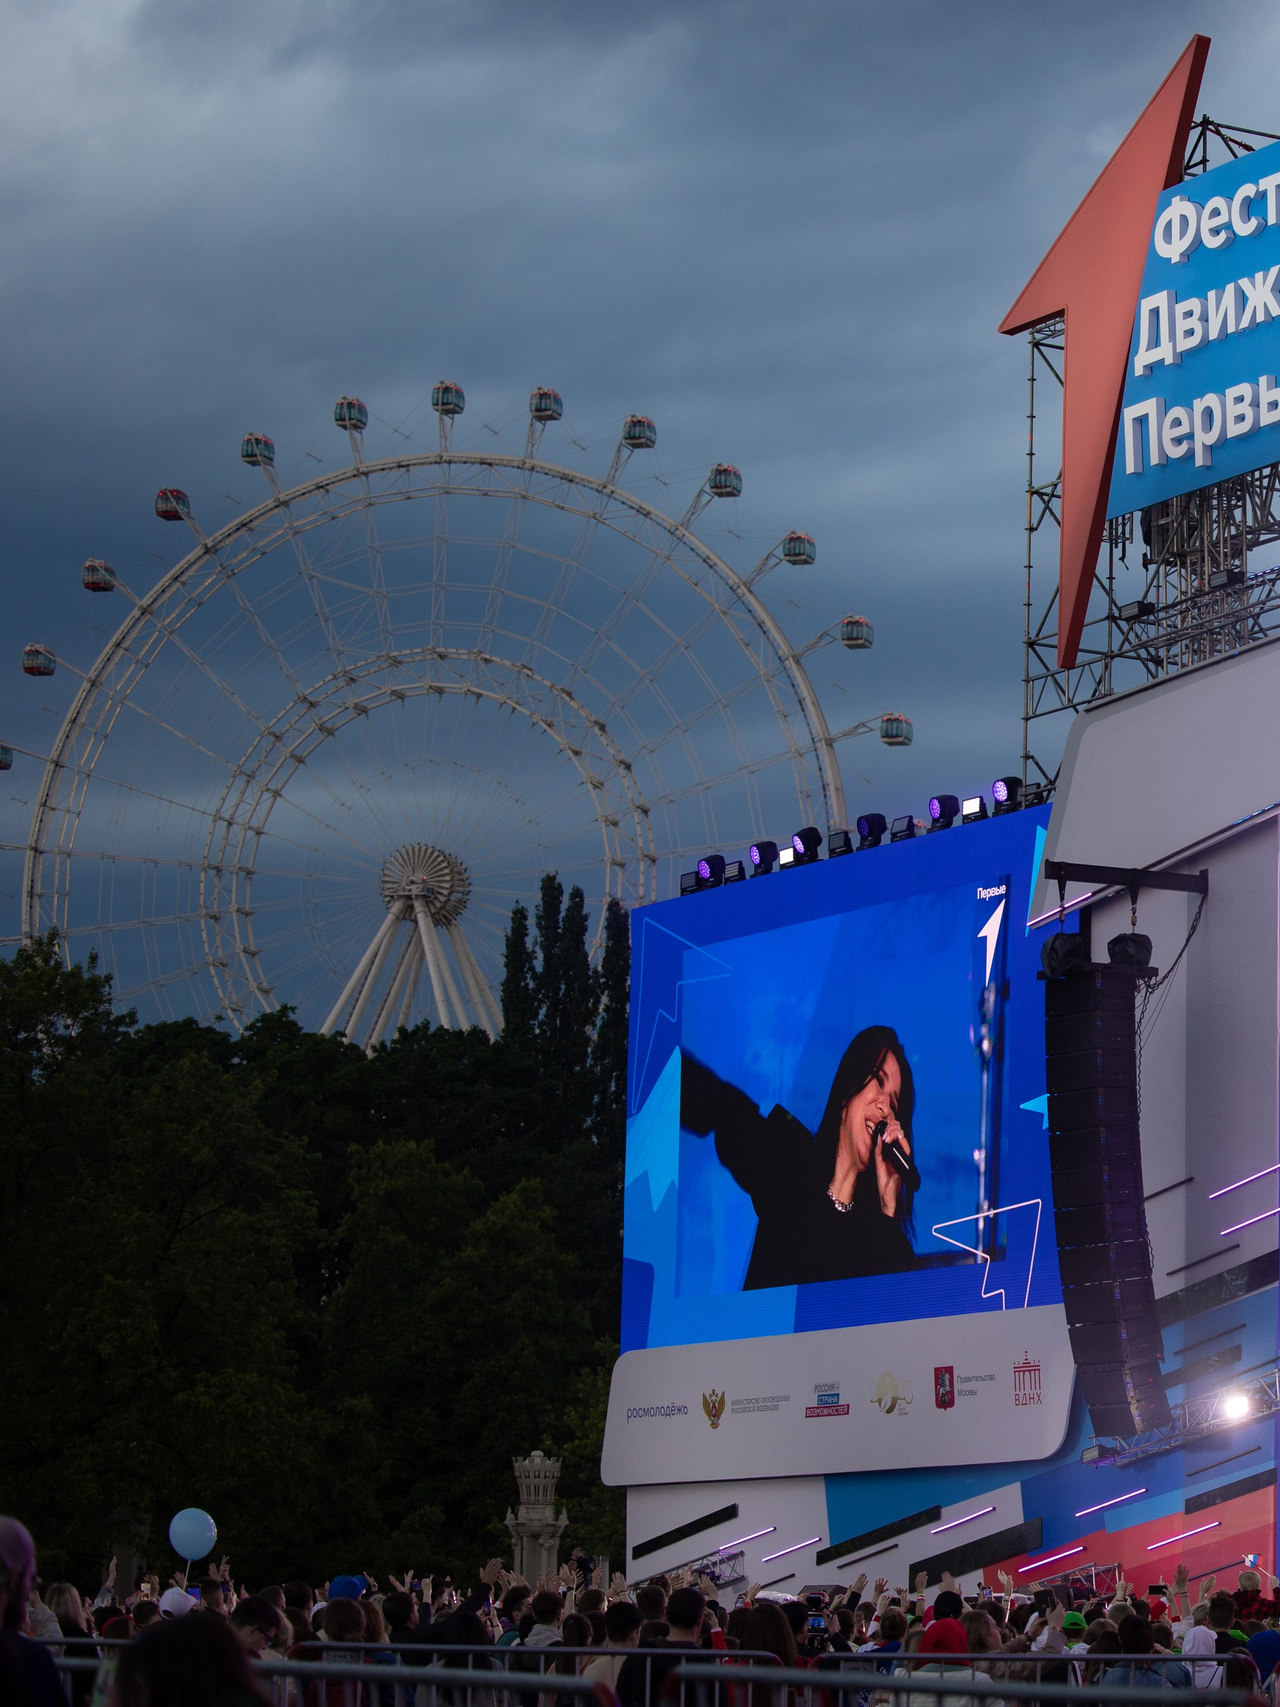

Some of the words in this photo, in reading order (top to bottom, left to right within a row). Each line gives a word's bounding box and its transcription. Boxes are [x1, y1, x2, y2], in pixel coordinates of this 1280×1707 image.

[977, 884, 1006, 901] Первые
[818, 1395, 839, 1405] СТРАНА
[1014, 1392, 1043, 1406] ВДНХ
[626, 1402, 689, 1425] росмолодёжь
[806, 1405, 848, 1417] ВОЗМОЖНОСТЕЙ
